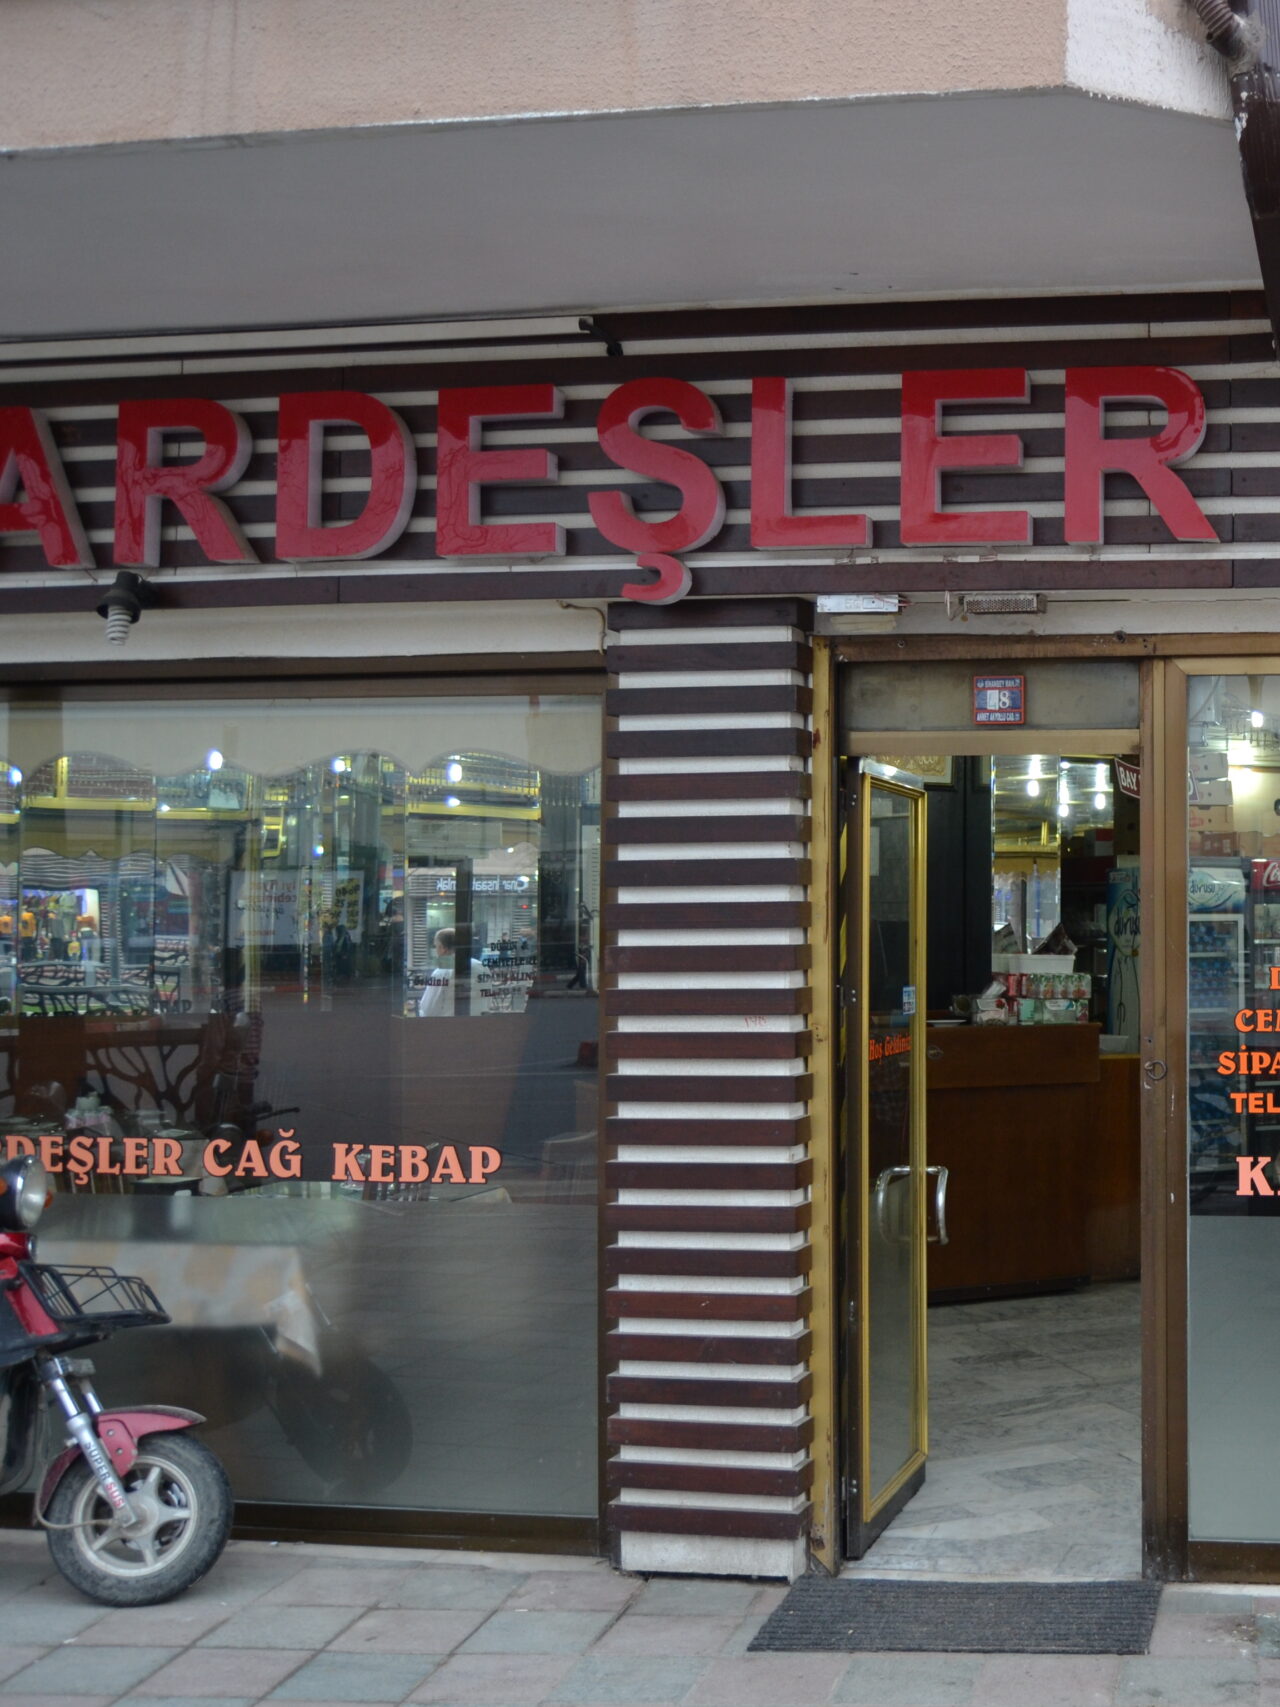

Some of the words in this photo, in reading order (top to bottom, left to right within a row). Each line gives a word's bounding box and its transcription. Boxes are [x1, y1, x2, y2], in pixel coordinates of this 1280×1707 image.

[1119, 766, 1138, 791] BAY
[0, 1133, 183, 1185] DEŞLER
[203, 1128, 302, 1178] CAĞ
[332, 1142, 501, 1184] KEBAP
[83, 1441, 111, 1481] SUPER
